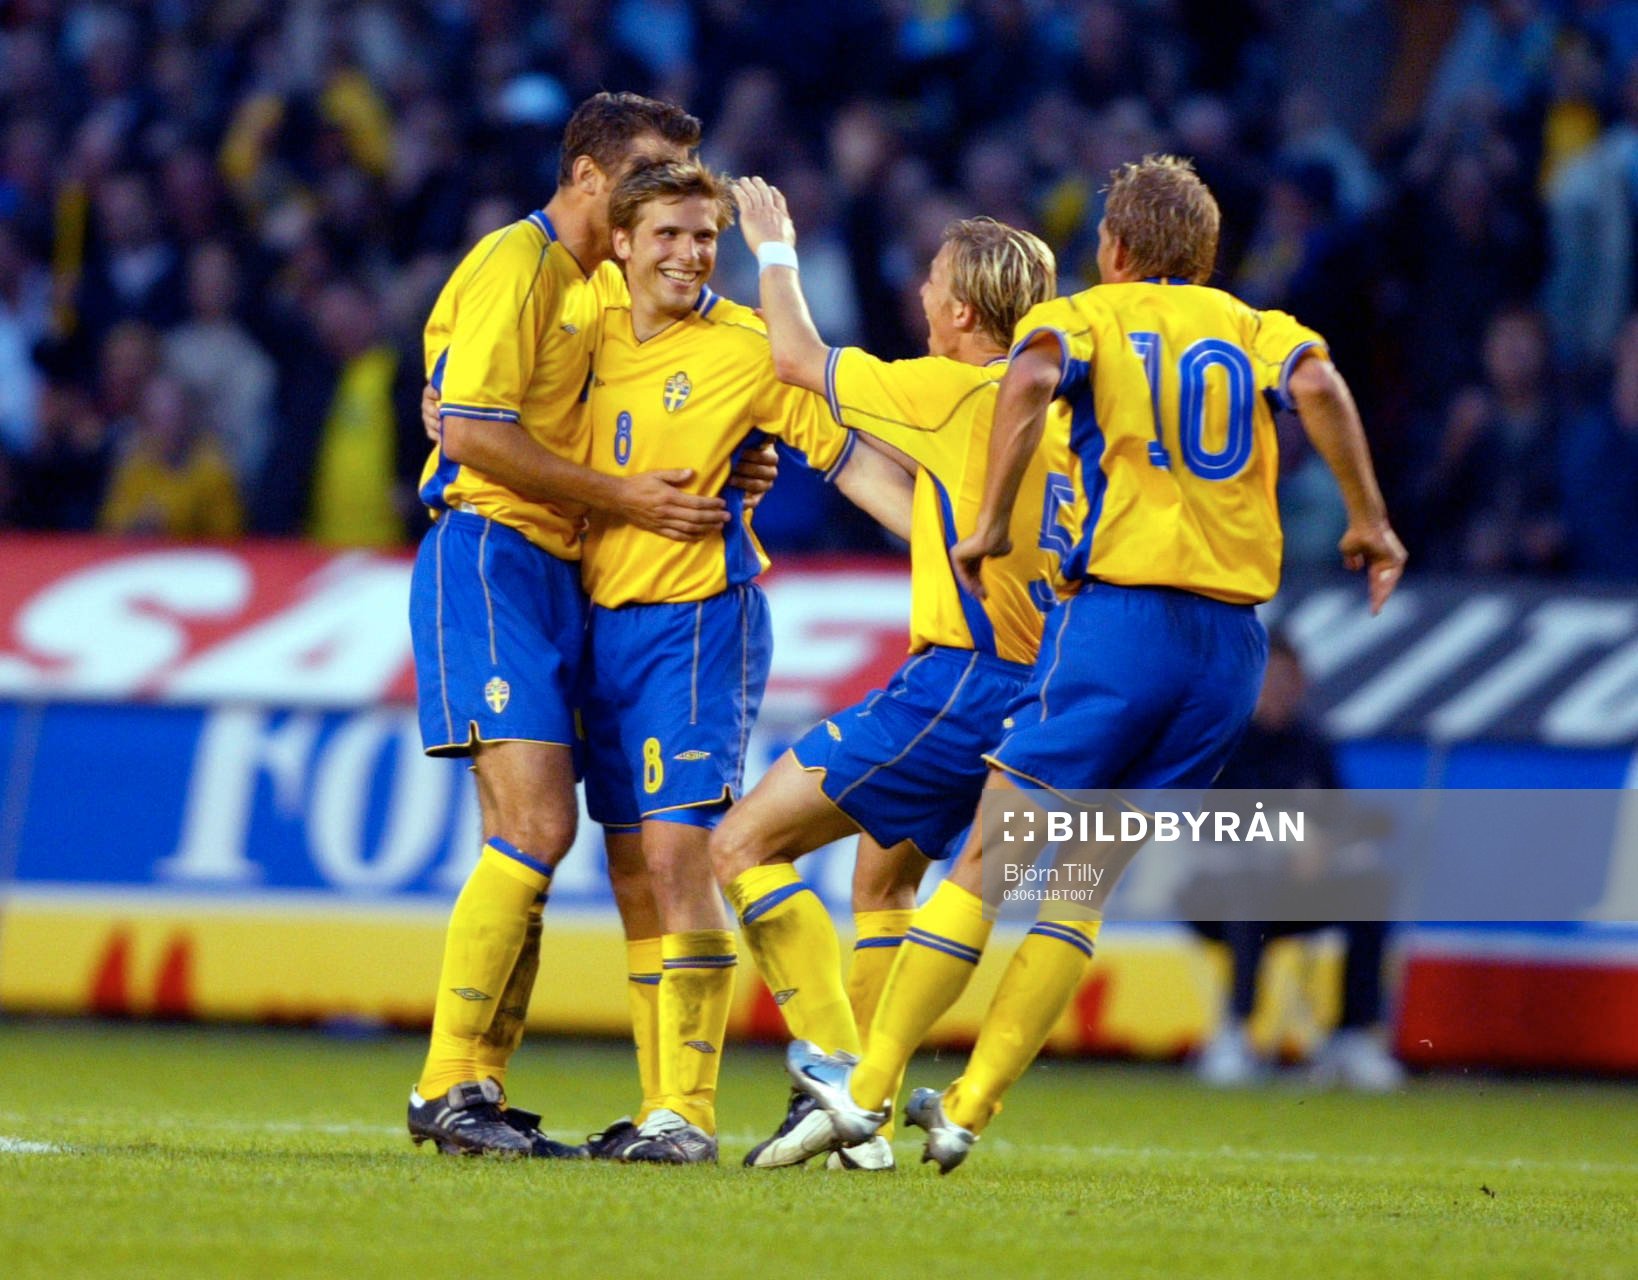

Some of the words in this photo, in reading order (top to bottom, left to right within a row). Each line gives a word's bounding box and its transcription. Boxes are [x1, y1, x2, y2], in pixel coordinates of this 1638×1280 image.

[614, 411, 632, 466] 8
[1128, 331, 1255, 482] 10
[1028, 472, 1076, 612] 5
[643, 736, 664, 794] 8
